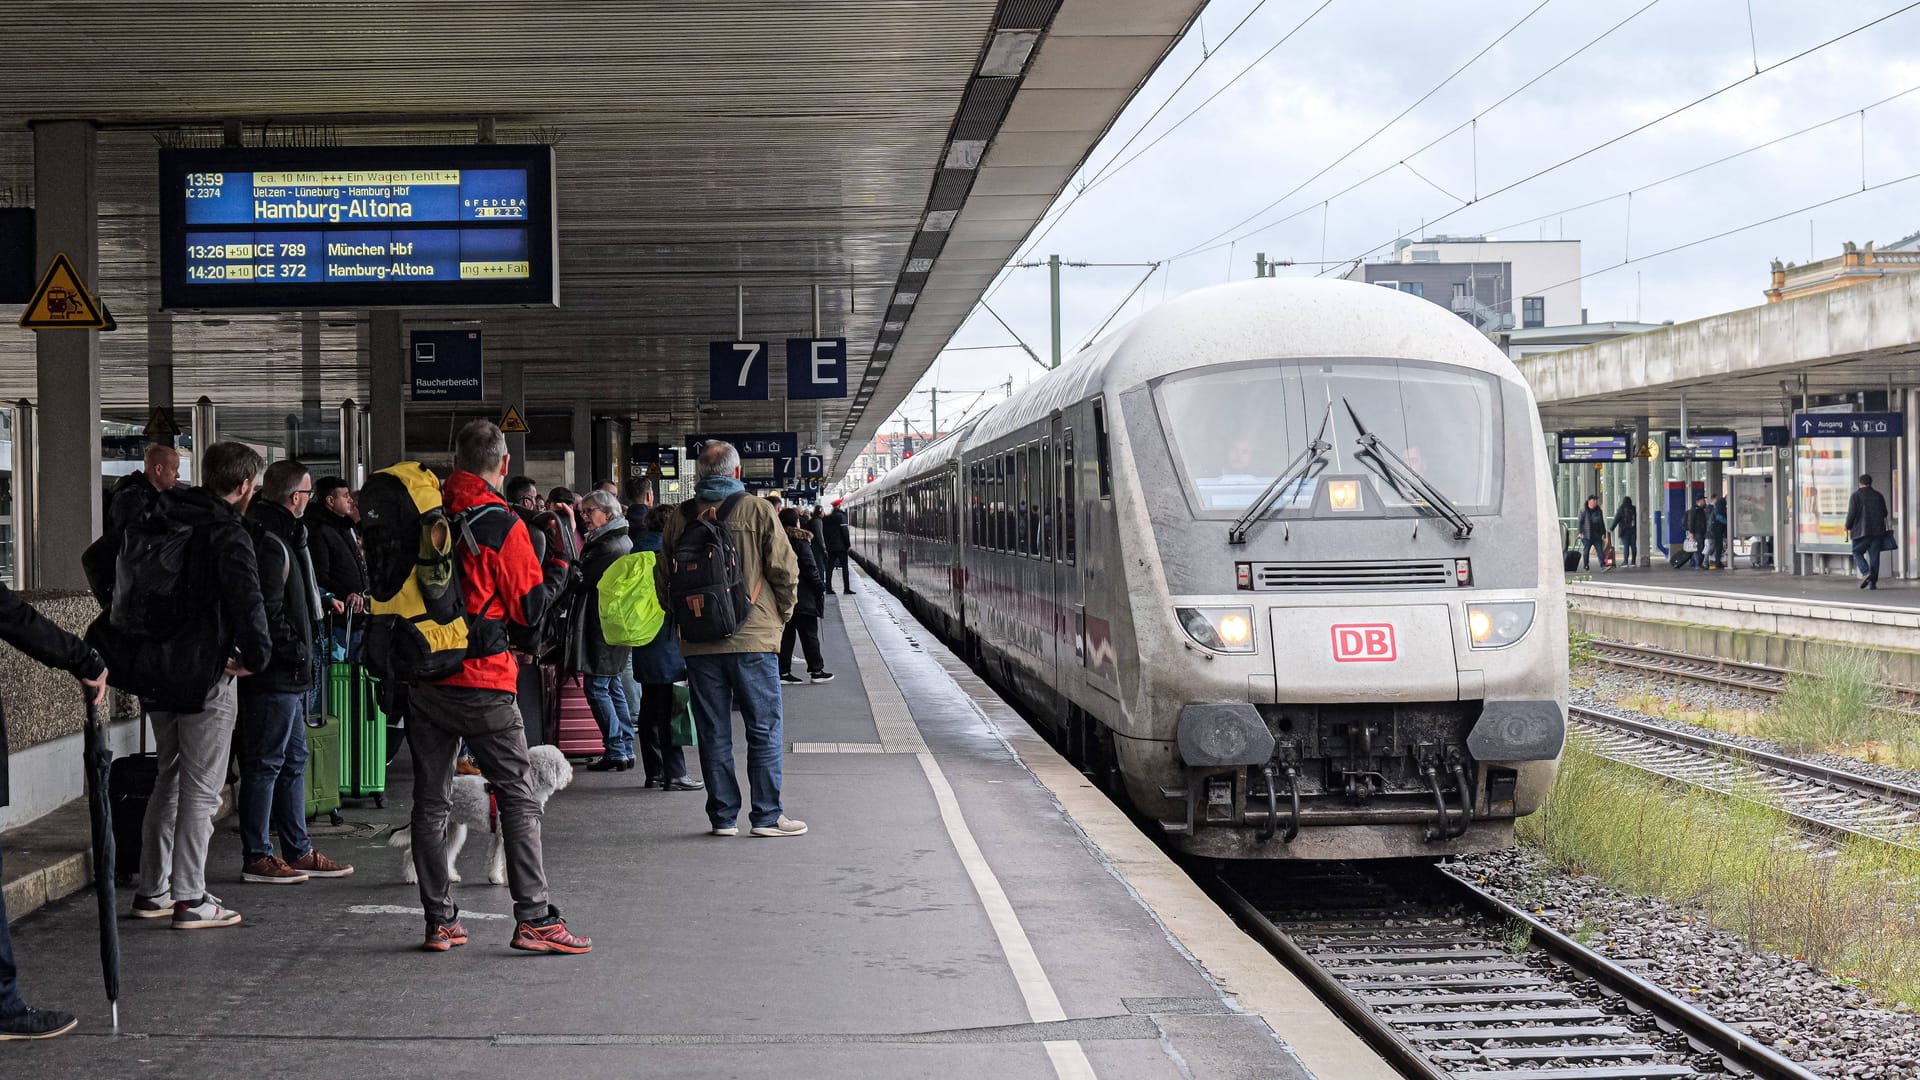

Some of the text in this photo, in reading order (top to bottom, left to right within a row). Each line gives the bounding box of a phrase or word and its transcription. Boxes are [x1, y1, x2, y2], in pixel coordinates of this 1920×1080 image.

[186, 173, 223, 186] 13:59
[260, 174, 276, 183] ca.
[281, 174, 293, 183] 10
[296, 173, 318, 182] Min.
[347, 172, 364, 181] Ein
[367, 172, 407, 183] Wagen
[411, 171, 441, 181] fehlt
[186, 188, 221, 198] IC 2374
[253, 187, 286, 197] Uelzen
[295, 186, 340, 199] Lüneburg
[348, 187, 391, 199] Hamburg
[393, 186, 410, 196] Hbf
[254, 199, 412, 222] Hamburg-Altona
[187, 243, 413, 258] 13:26 +50 ICE 789 München Hbf
[187, 266, 225, 279] 14:20
[229, 268, 249, 277] +10
[254, 265, 275, 277] ICE
[280, 264, 306, 277] 372
[328, 262, 434, 279] Hamburg-Altona
[507, 263, 528, 273] Fah
[732, 343, 761, 387] 7
[810, 341, 839, 384] E
[416, 378, 478, 386] Raucherbereich
[780, 457, 793, 473] 7
[808, 456, 821, 473] D
[1340, 630, 1389, 656] DB
